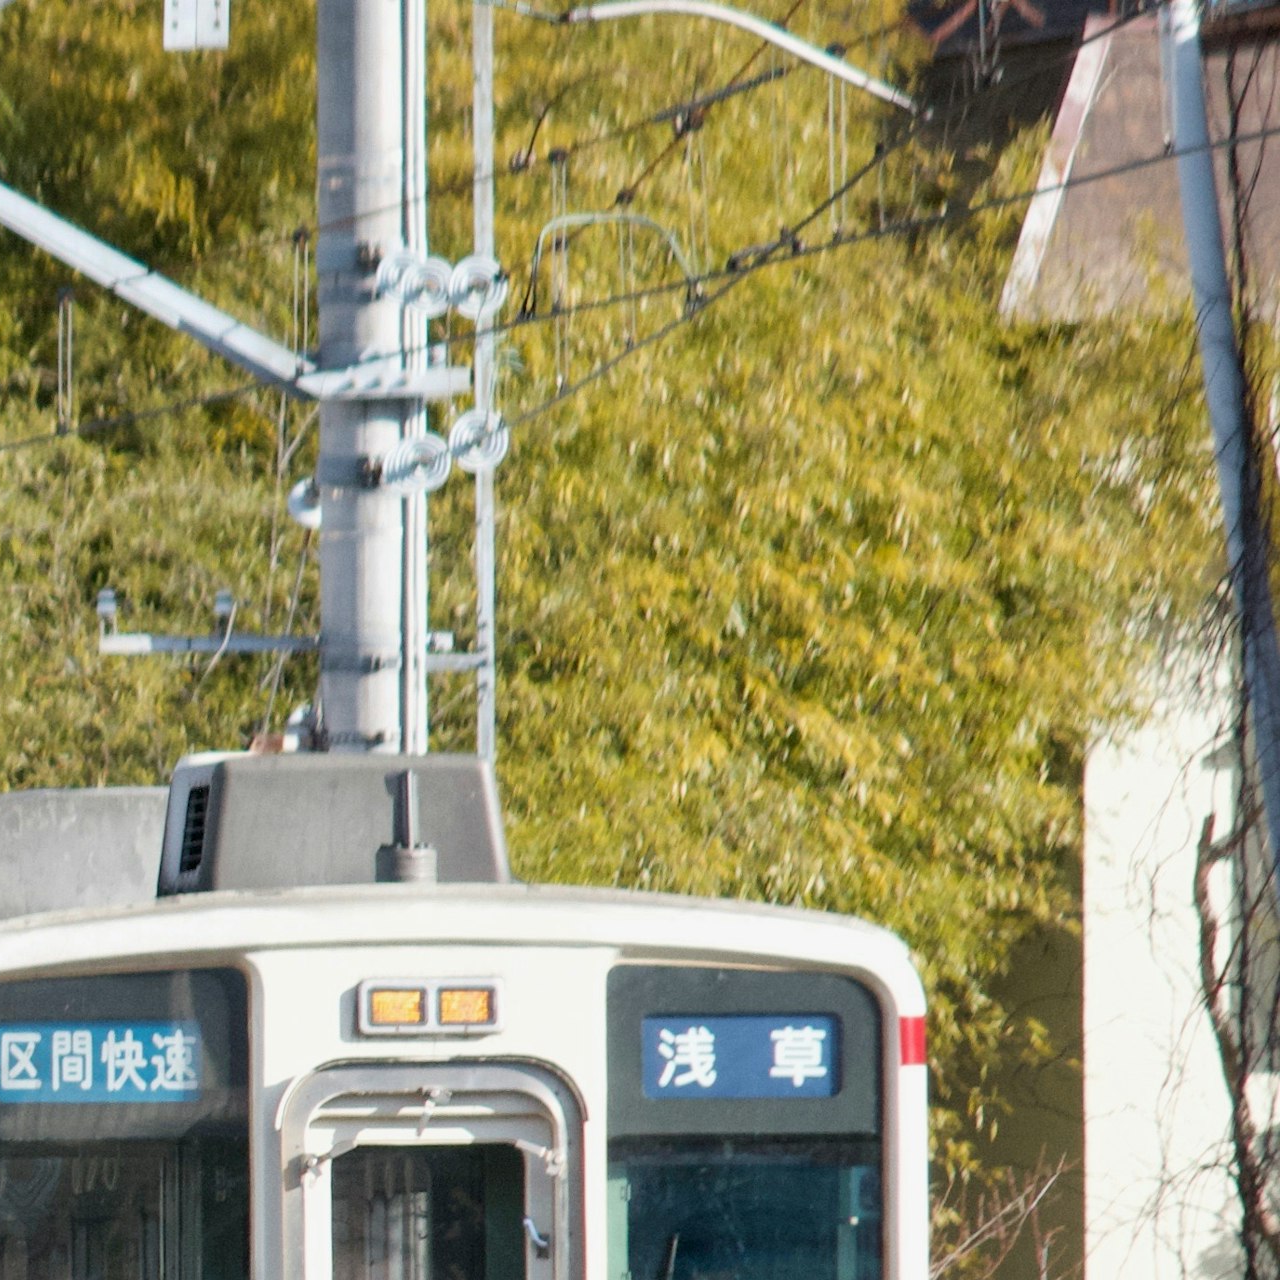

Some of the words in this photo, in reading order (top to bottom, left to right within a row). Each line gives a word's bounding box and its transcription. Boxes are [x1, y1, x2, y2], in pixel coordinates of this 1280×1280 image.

[0, 1028, 199, 1092] 区間快速
[657, 1024, 828, 1089] 浅草
